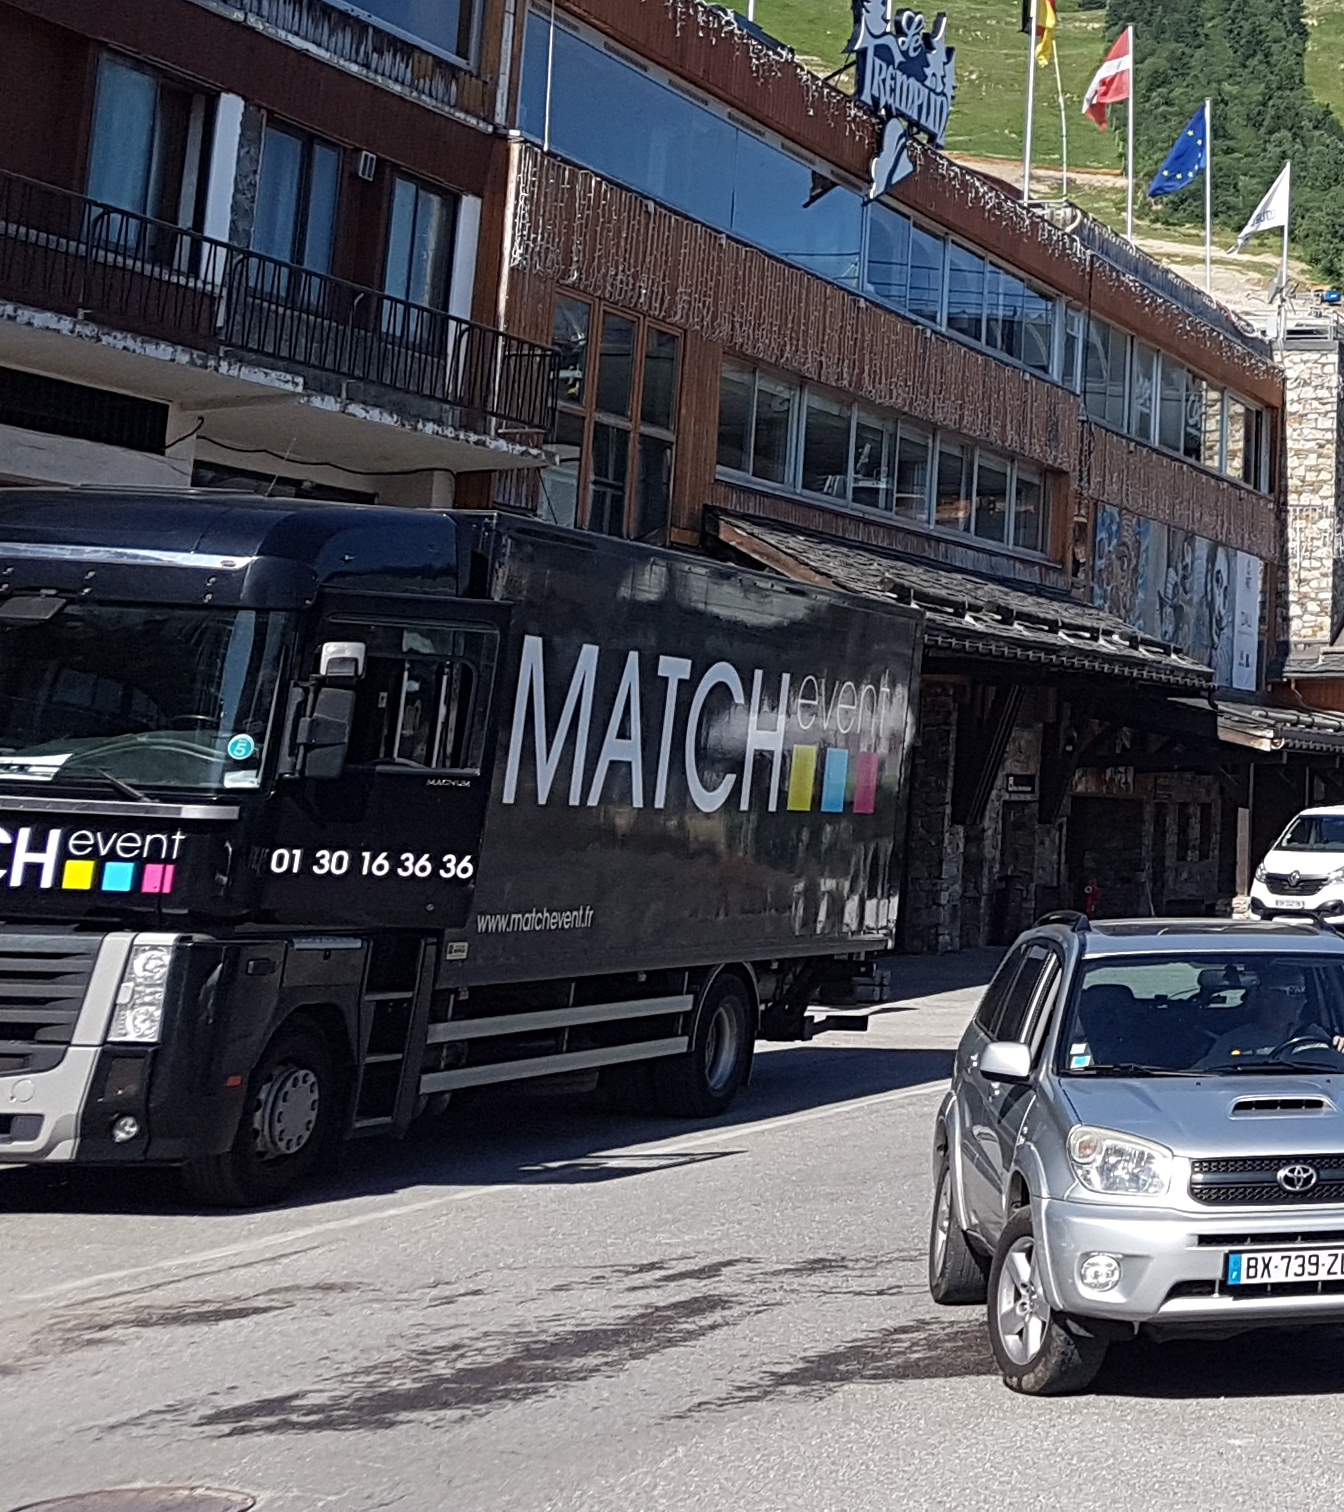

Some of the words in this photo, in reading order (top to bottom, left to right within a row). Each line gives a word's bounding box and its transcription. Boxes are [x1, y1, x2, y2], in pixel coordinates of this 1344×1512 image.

[502, 634, 790, 813] MATCH
[796, 669, 891, 738] event
[68, 829, 187, 859] event
[270, 848, 302, 875] 01
[312, 848, 349, 876] 30
[361, 850, 390, 877] 16
[397, 851, 433, 878] 36
[439, 852, 474, 879] 36
[477, 905, 594, 933] www.matchevent.fr
